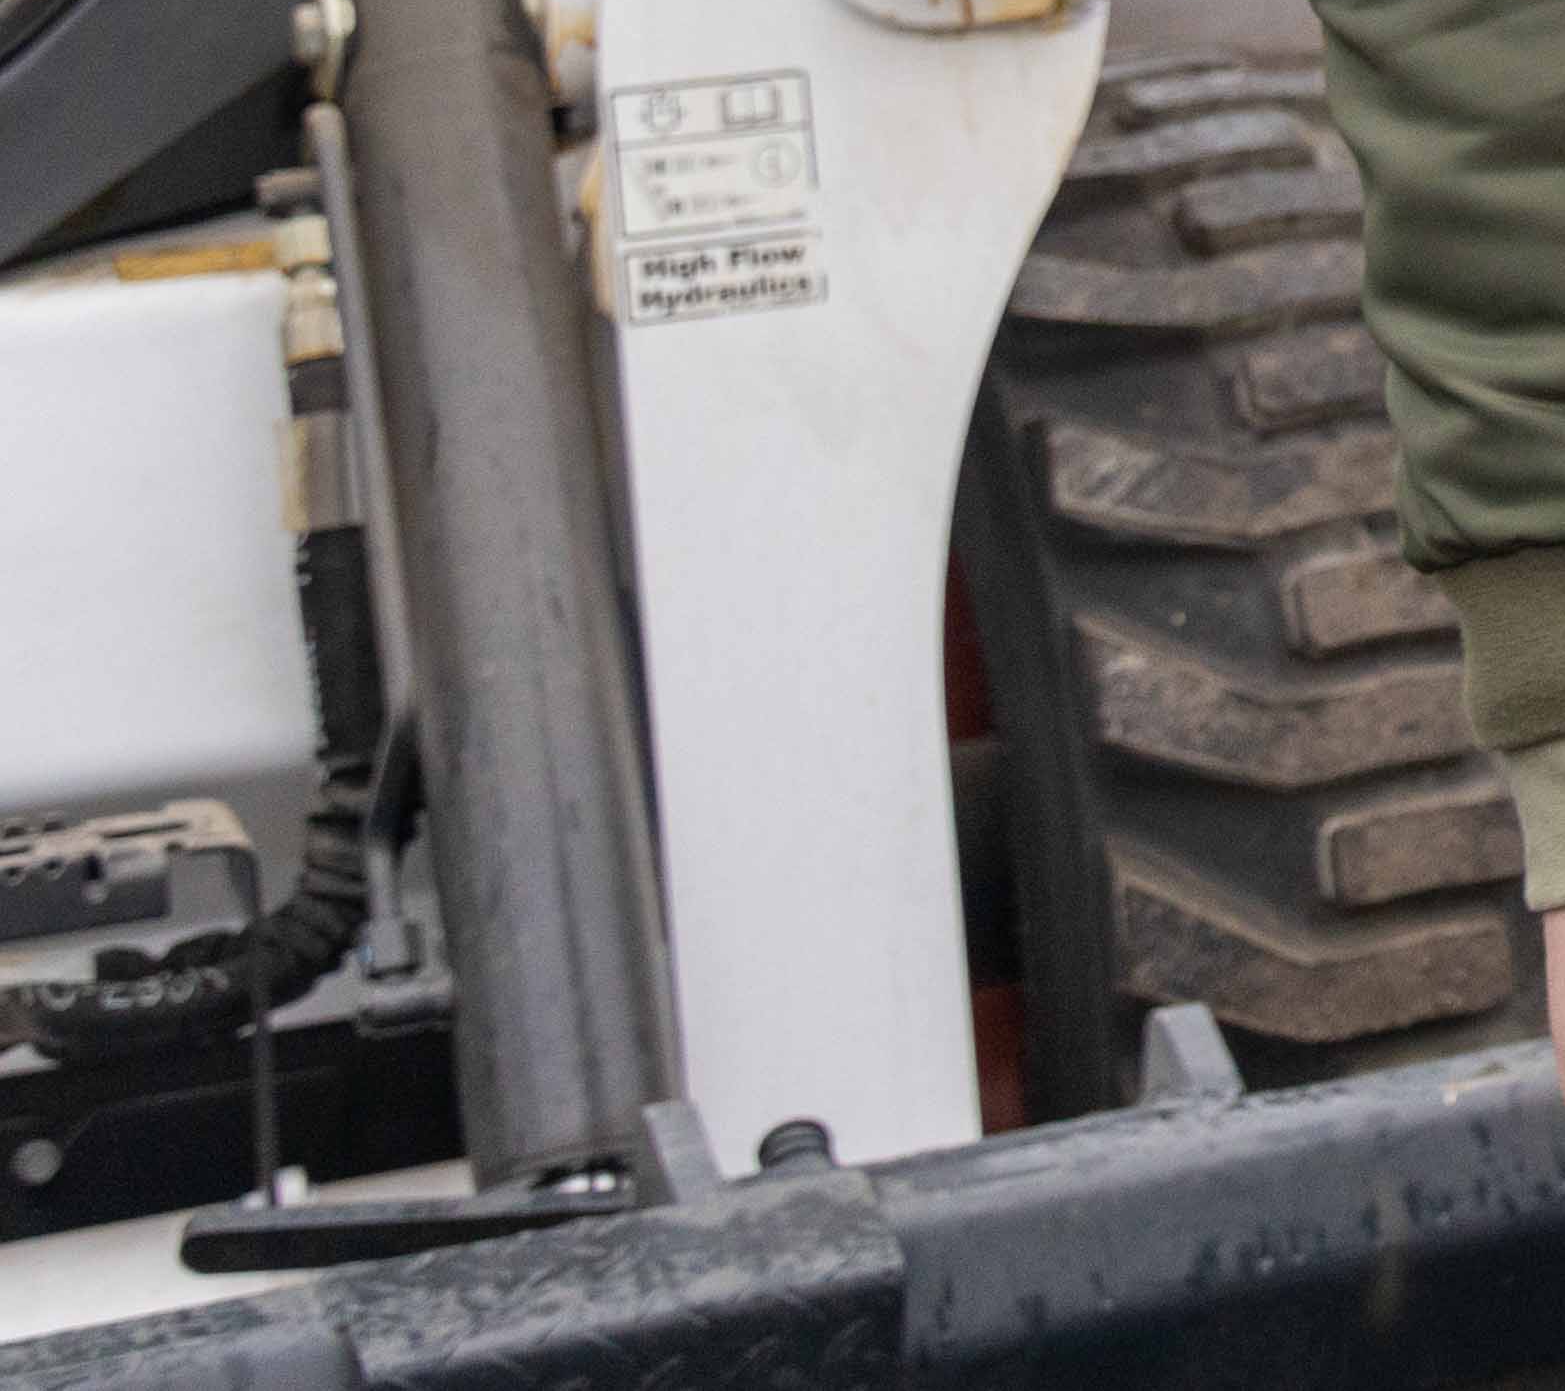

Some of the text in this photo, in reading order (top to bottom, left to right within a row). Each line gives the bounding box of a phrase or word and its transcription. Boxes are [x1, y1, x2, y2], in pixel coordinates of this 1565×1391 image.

[643, 244, 805, 280] High Flow
[640, 276, 811, 317] Hydraulics
